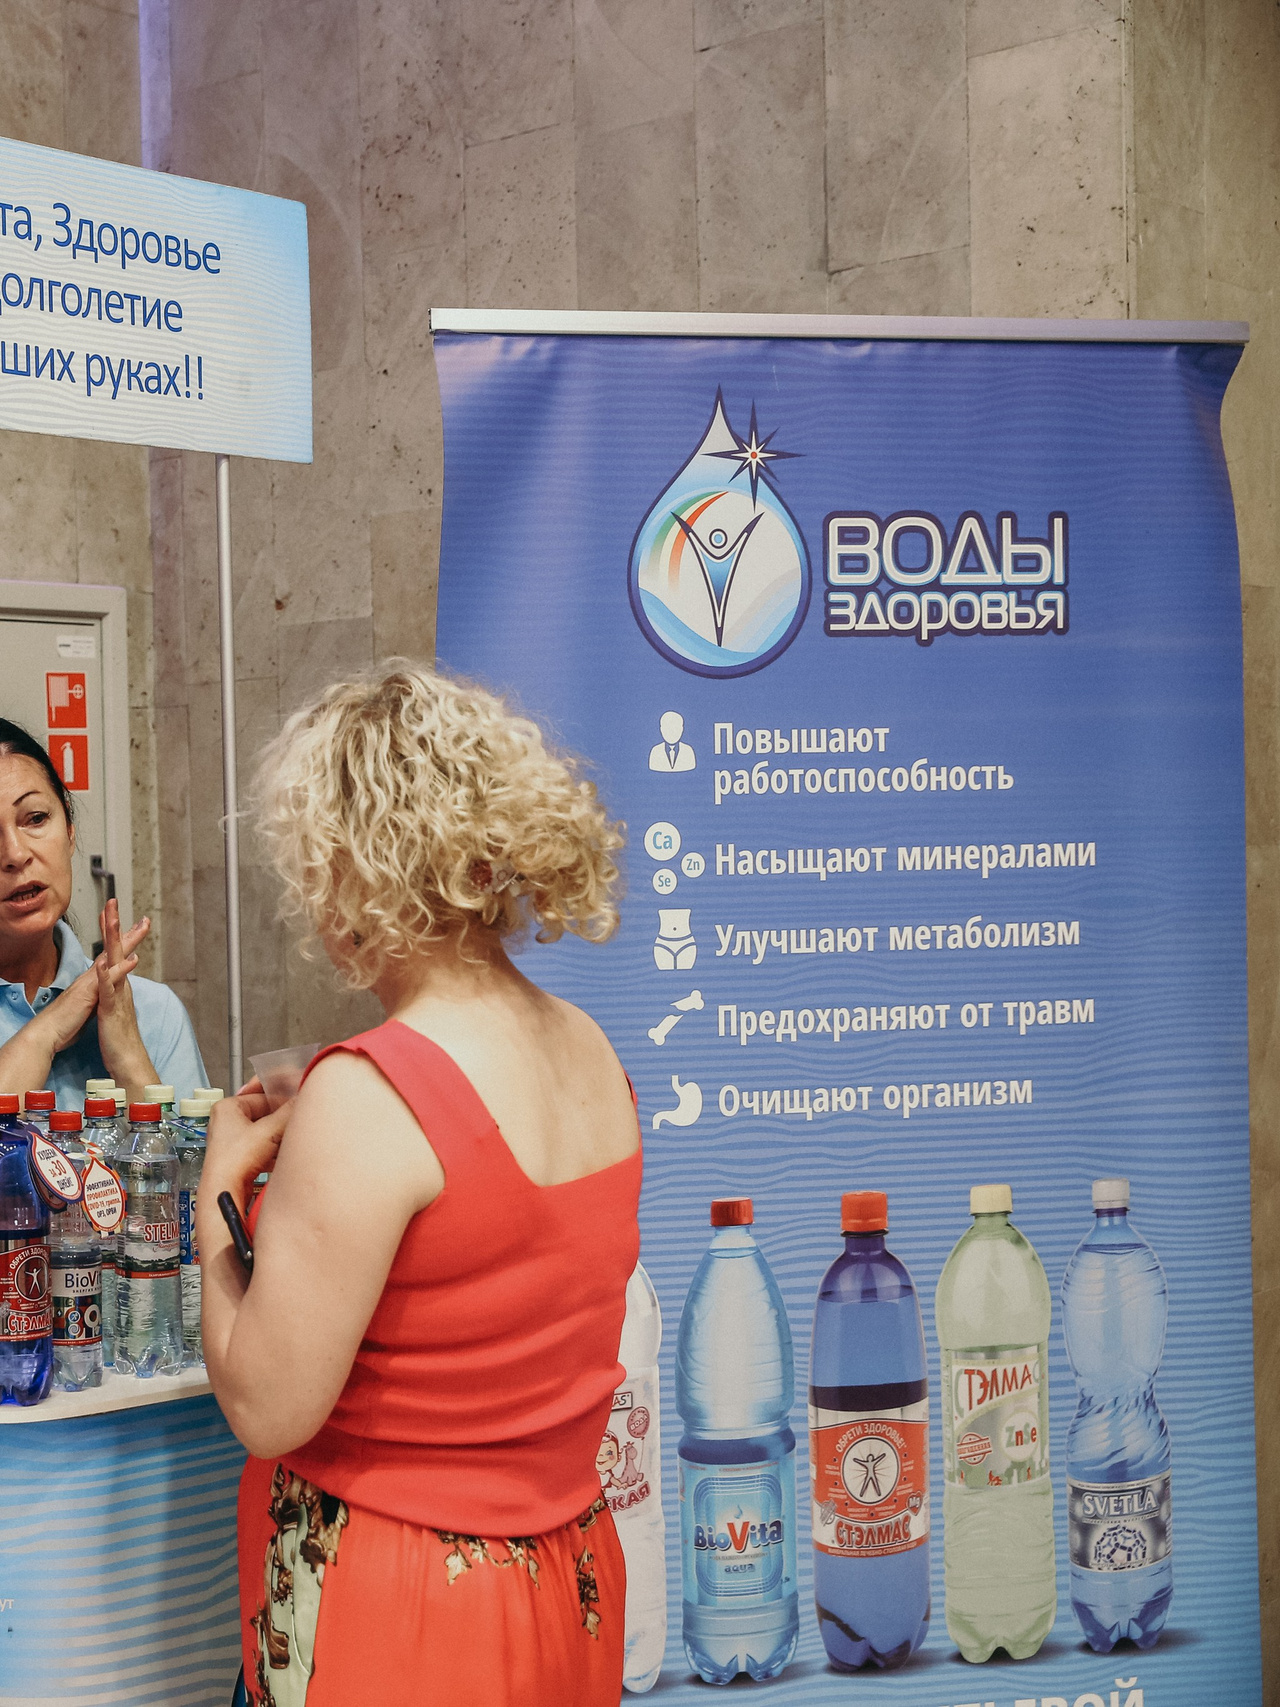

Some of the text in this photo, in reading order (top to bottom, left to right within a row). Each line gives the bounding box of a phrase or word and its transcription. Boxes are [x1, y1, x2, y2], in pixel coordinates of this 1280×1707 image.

[53, 203, 220, 274] Здоровье
[86, 354, 204, 400] руках!!
[827, 516, 1064, 585] ВОДЫ
[714, 722, 890, 754] Повышают
[715, 759, 1014, 805] работоспособность
[652, 830, 673, 850] Ca
[686, 858, 700, 871] Zn
[716, 841, 1097, 880] Насыщают минералами
[658, 875, 671, 887] Se
[715, 915, 1080, 965] Улучшают метаболизм
[718, 998, 1095, 1045] Предохраняют от травм
[720, 1079, 1033, 1120] Очищают организм
[51, 1160, 66, 1176] 30
[8, 1311, 51, 1332] СТЭЛМА
[836, 1425, 862, 1452] ОБРЕТИ
[1083, 1489, 1158, 1516] SVETLA
[694, 1520, 783, 1553] BioVita
[835, 1514, 911, 1547] СТЭЛМАС
[724, 1563, 755, 1573] aqua
